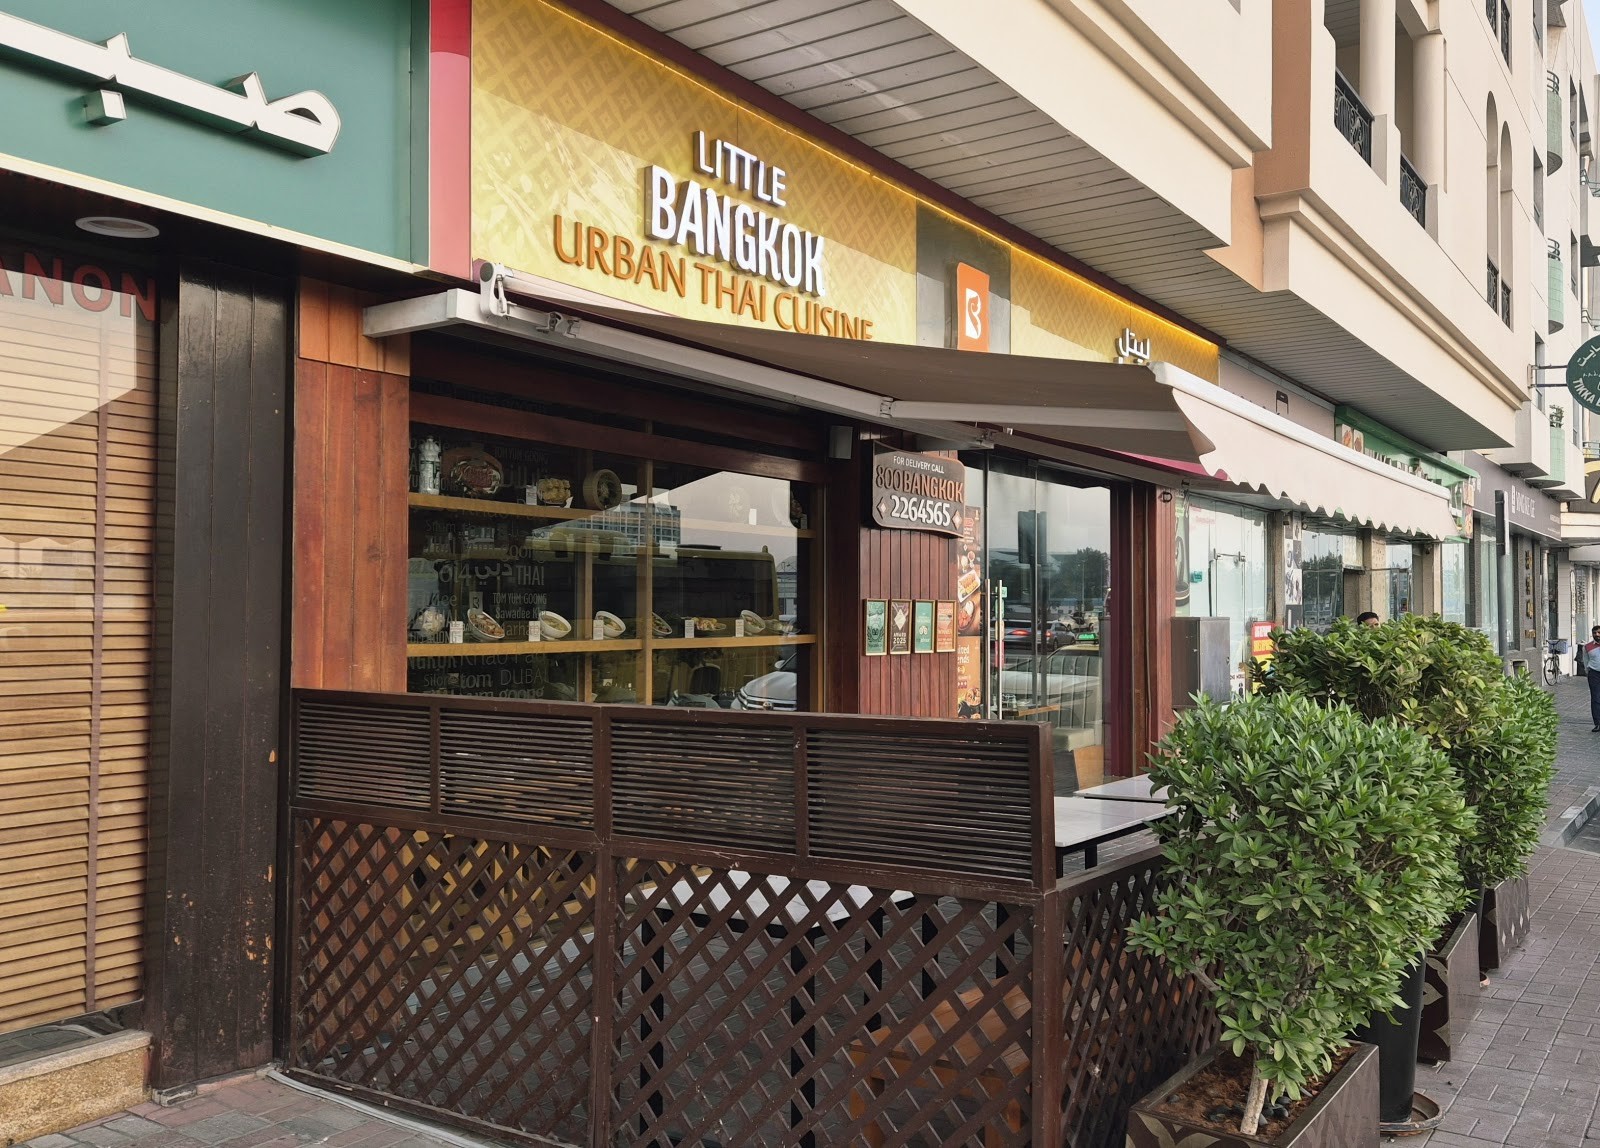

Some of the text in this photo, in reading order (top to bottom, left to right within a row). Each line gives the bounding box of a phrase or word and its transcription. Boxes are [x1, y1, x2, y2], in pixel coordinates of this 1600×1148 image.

[694, 131, 786, 207] LITTLE
[645, 164, 826, 297] BANGKOK
[553, 214, 874, 340] URBAN THAI CUISINE
[1573, 377, 1596, 403] TIKKA
[893, 456, 945, 474] FOR DELIVERY CALL
[890, 494, 951, 527] 2264565
[516, 564, 545, 586] THAI
[493, 592, 547, 605] TOM YUM GOONG
[495, 606, 531, 619] Sawadee
[460, 671, 493, 689] tom
[499, 668, 550, 686] DUBAI
